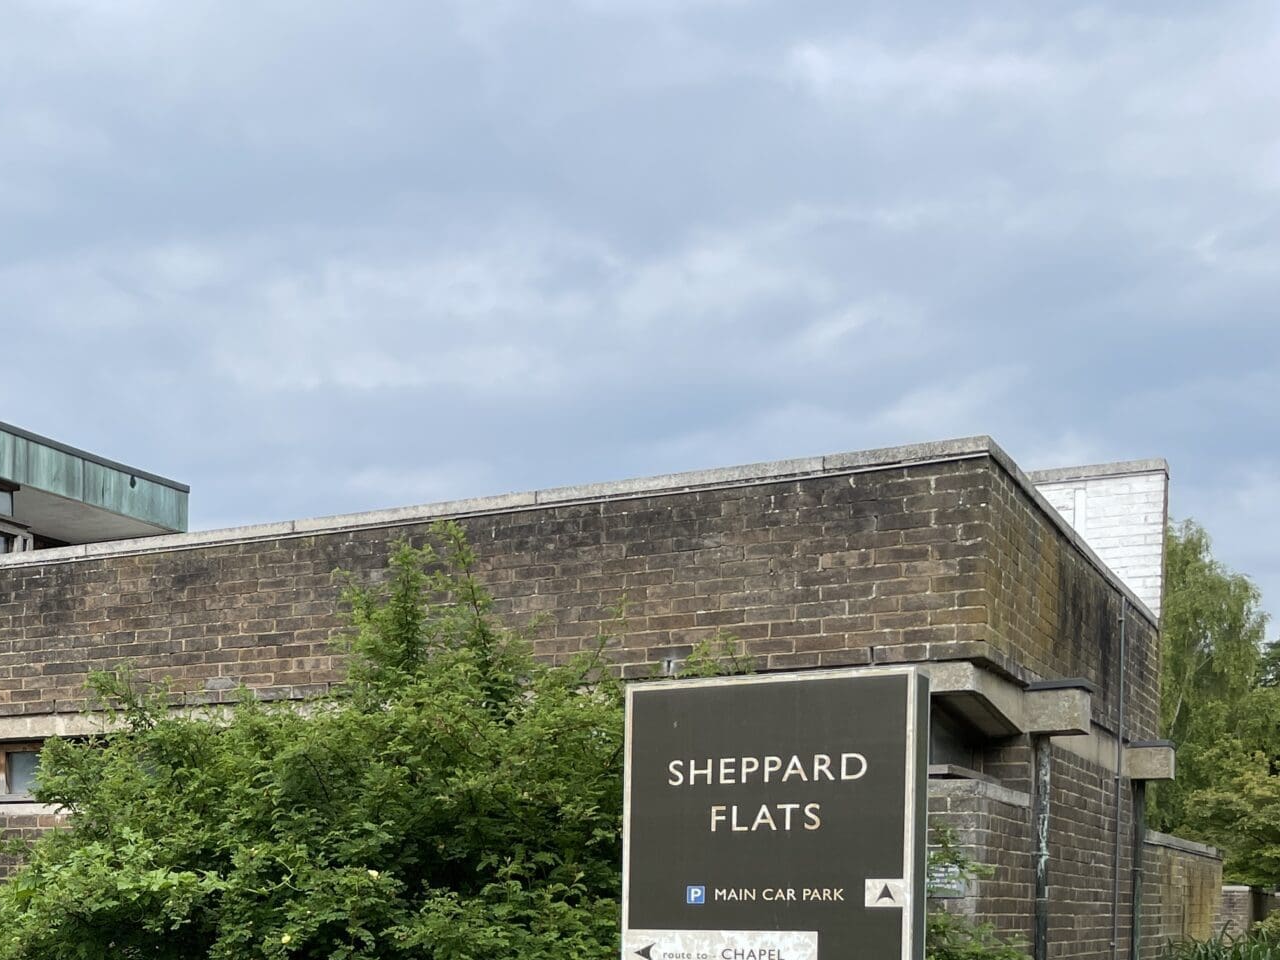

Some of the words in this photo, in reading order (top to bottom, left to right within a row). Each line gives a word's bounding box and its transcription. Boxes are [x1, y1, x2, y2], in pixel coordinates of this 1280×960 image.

[668, 753, 868, 786] SHEPPARD
[710, 803, 822, 832] FLATS
[714, 888, 756, 901] MAIN
[762, 888, 797, 901] CAR
[802, 888, 844, 901] PARK
[662, 950, 693, 960] route
[696, 951, 708, 960] to
